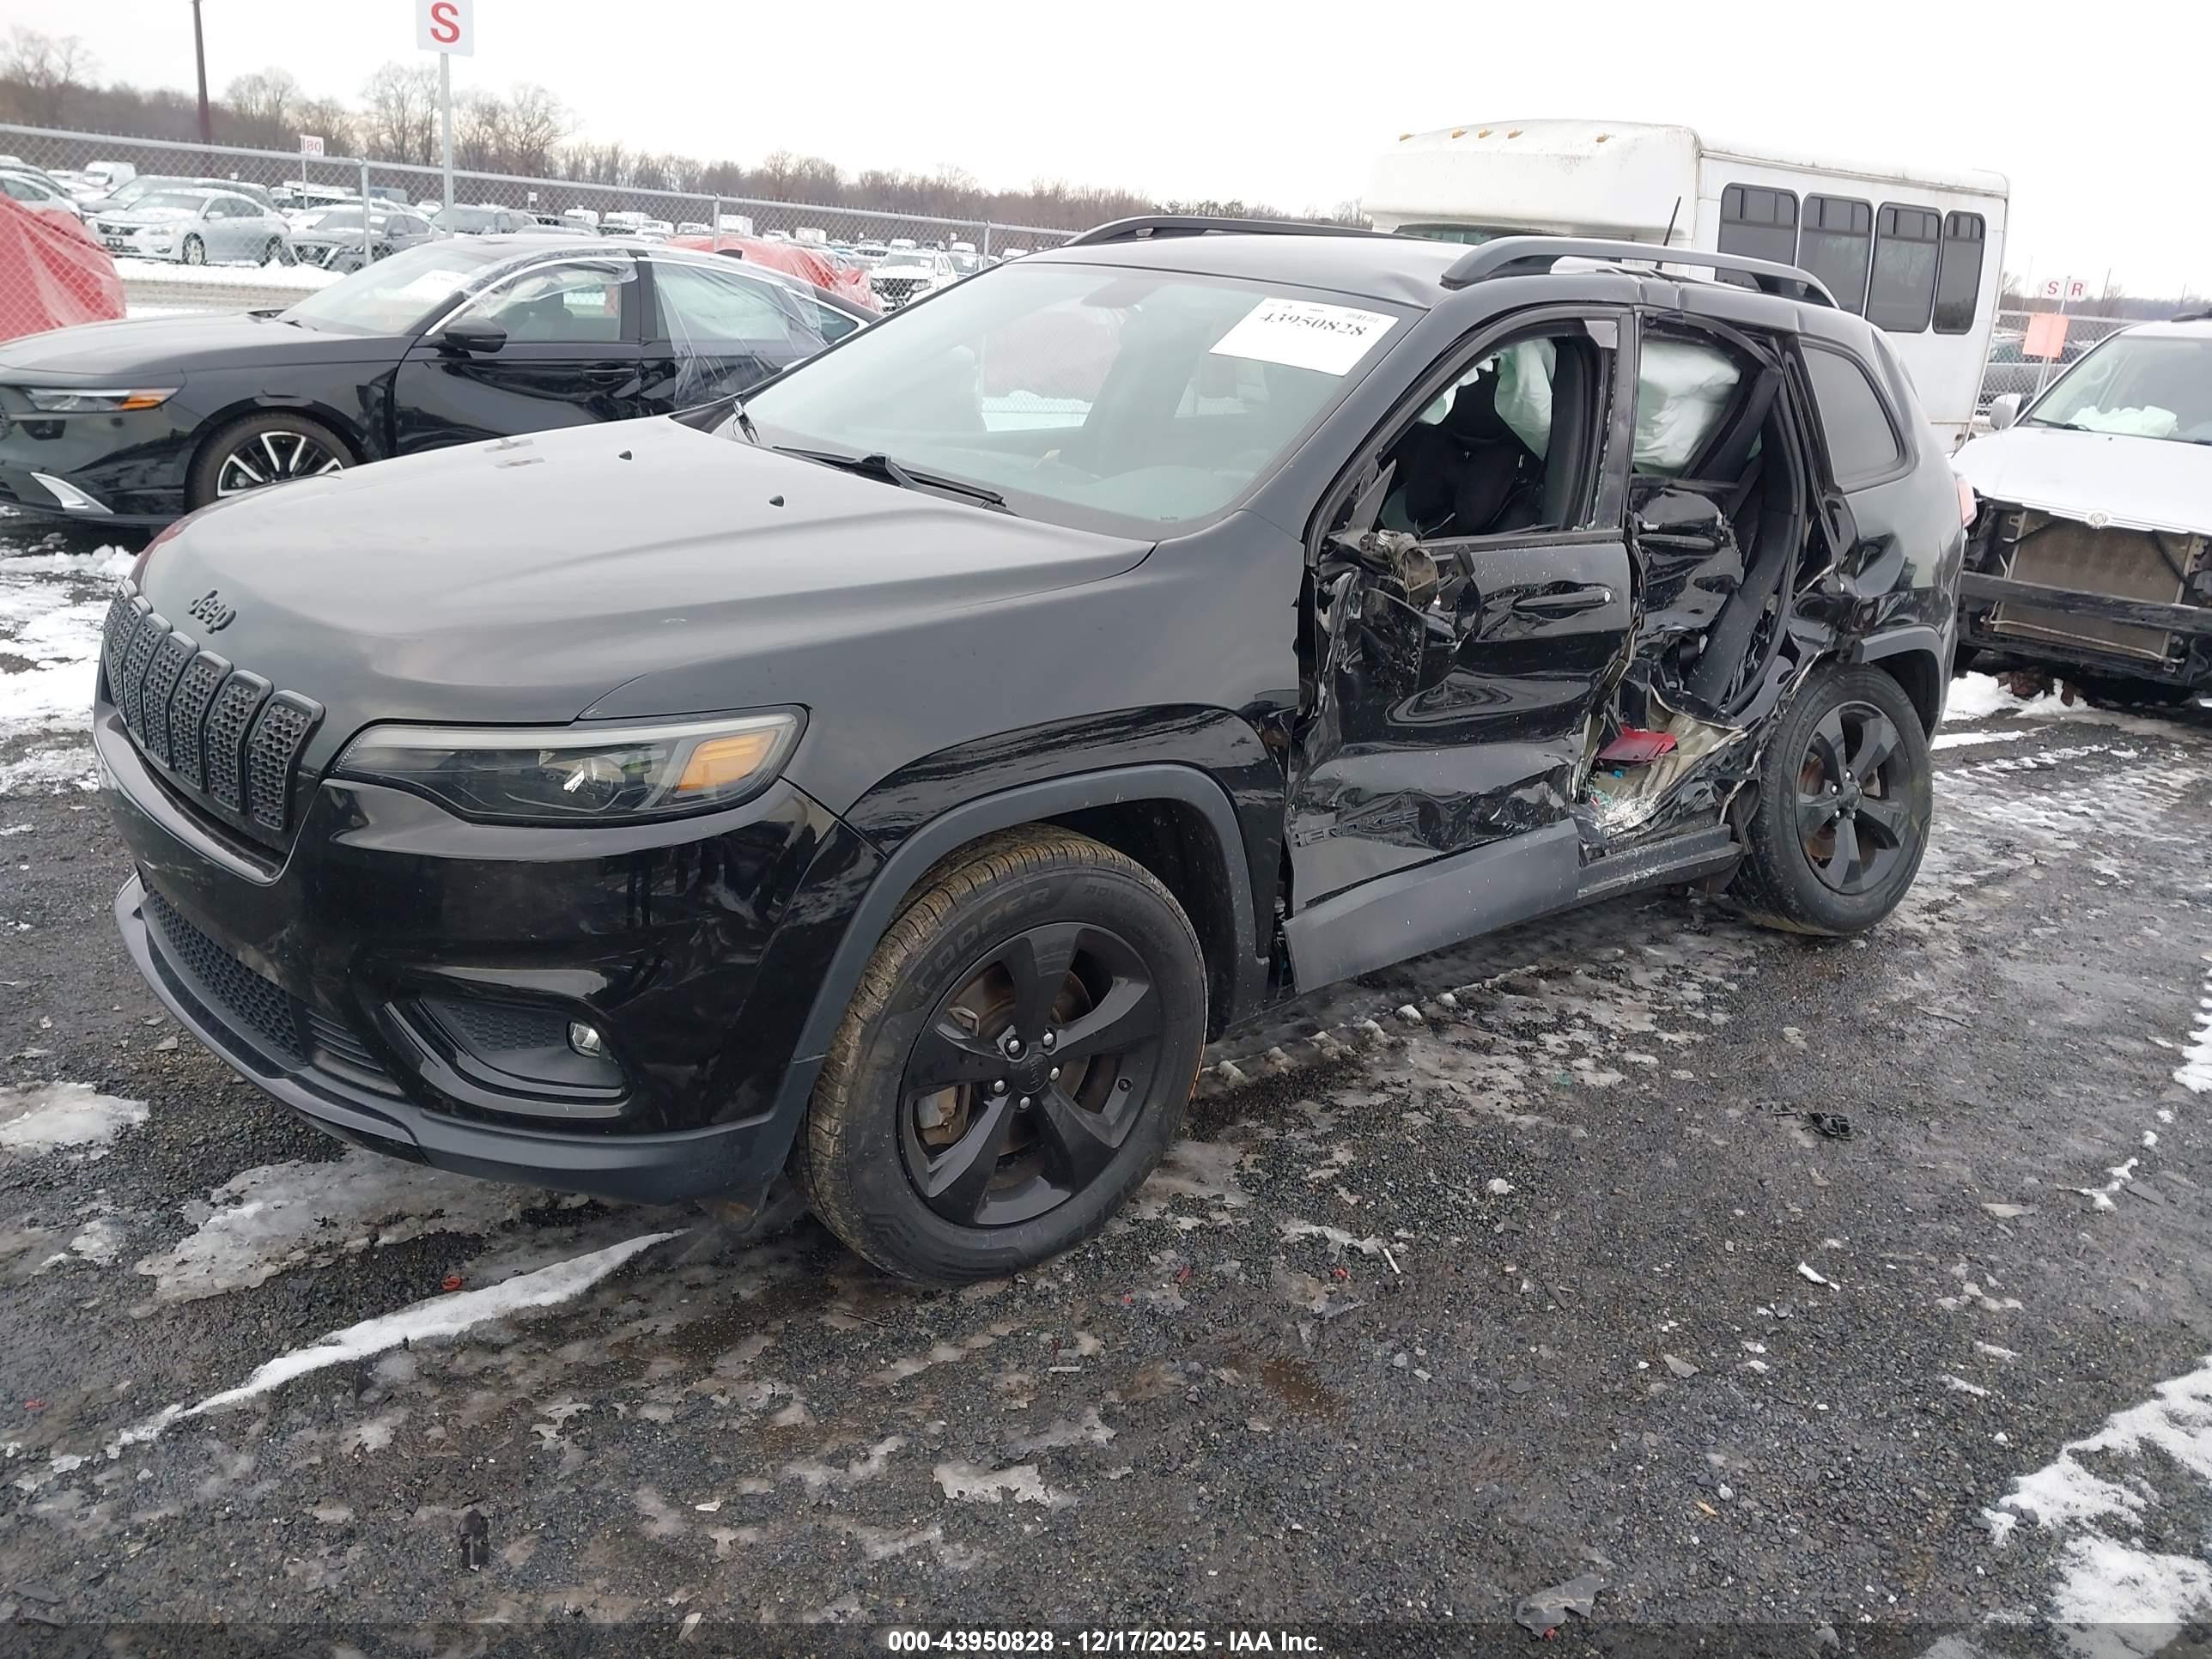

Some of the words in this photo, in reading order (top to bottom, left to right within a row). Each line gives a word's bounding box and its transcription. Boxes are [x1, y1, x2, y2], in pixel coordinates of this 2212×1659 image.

[430, 2, 460, 43] S
[2047, 281, 2059, 295] S
[2071, 282, 2084, 296] R
[1259, 313, 1368, 337] 43950828
[188, 589, 236, 635] Jeep
